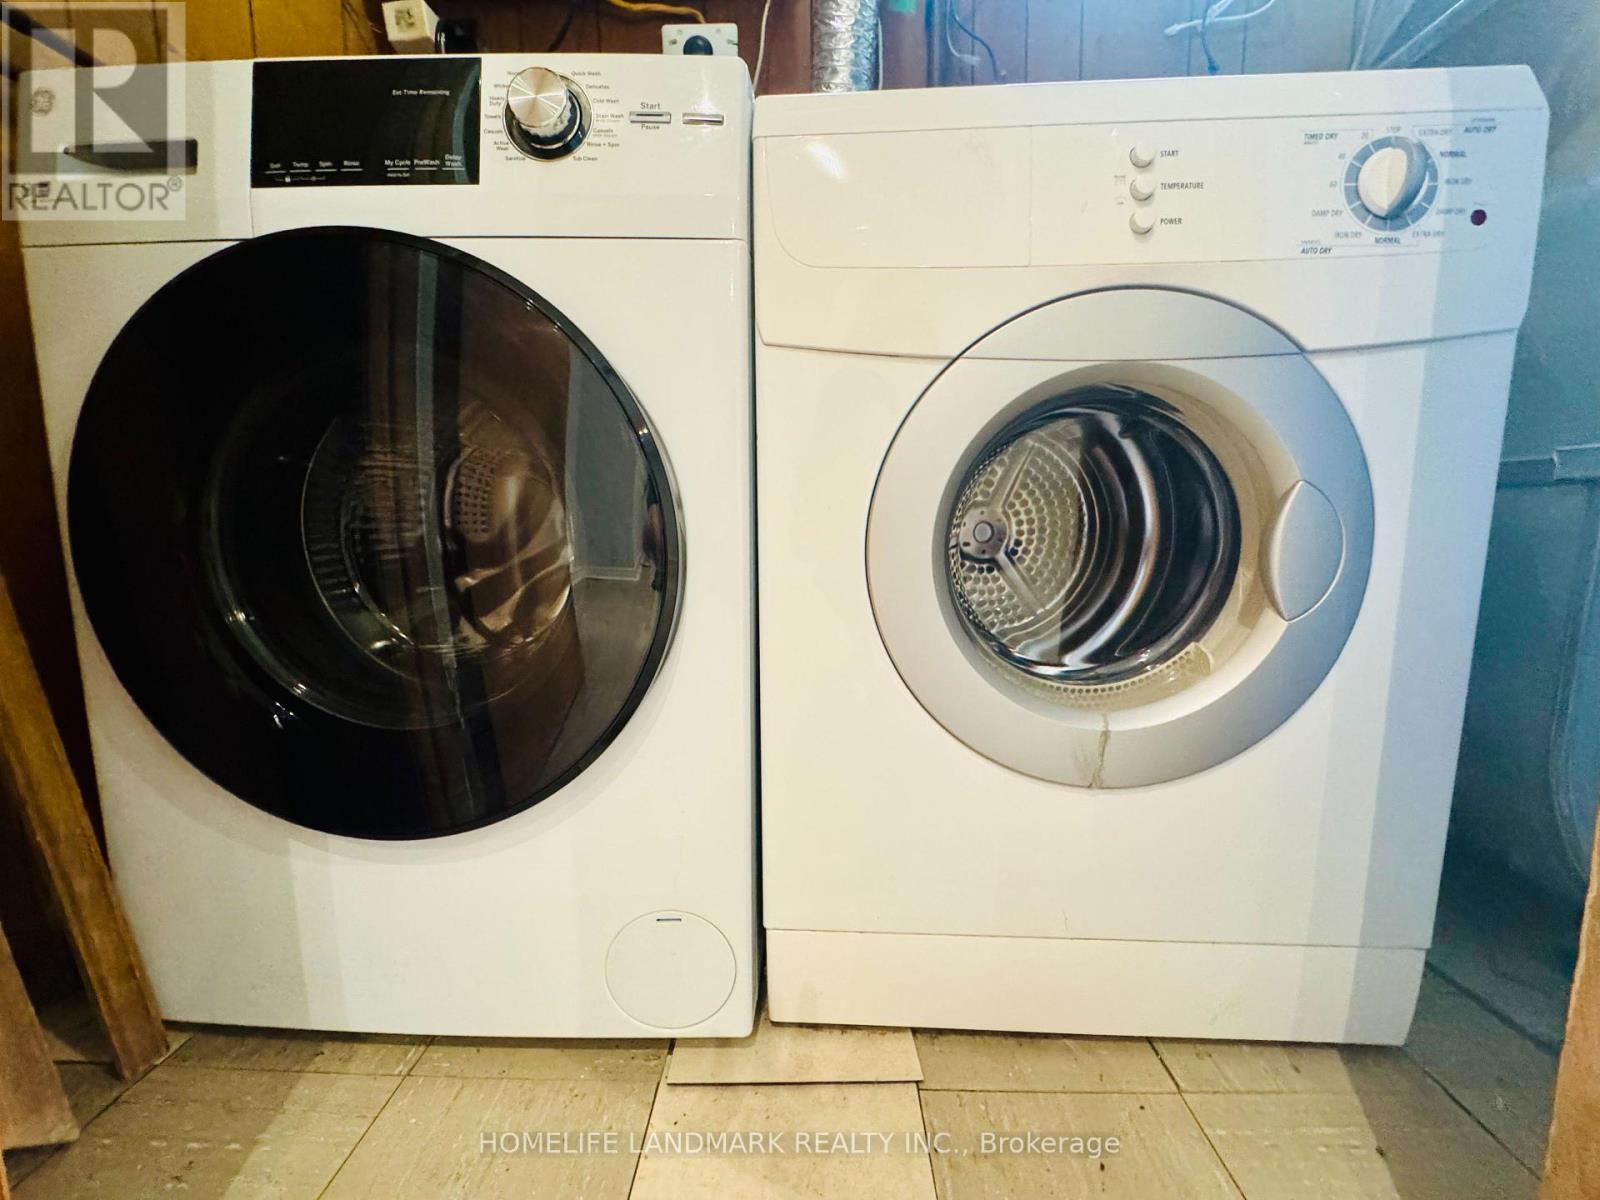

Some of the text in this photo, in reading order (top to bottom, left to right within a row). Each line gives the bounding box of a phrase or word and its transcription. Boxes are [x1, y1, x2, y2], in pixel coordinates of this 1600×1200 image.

[640, 101, 661, 110] Start
[1303, 132, 1339, 141] TIMED DRY
[1160, 149, 1179, 158] START
[1160, 182, 1205, 190] TEMPERATURE
[1160, 217, 1183, 225] POWER
[1374, 236, 1401, 244] NORMAL
[1300, 247, 1333, 255] AUTO DRY
